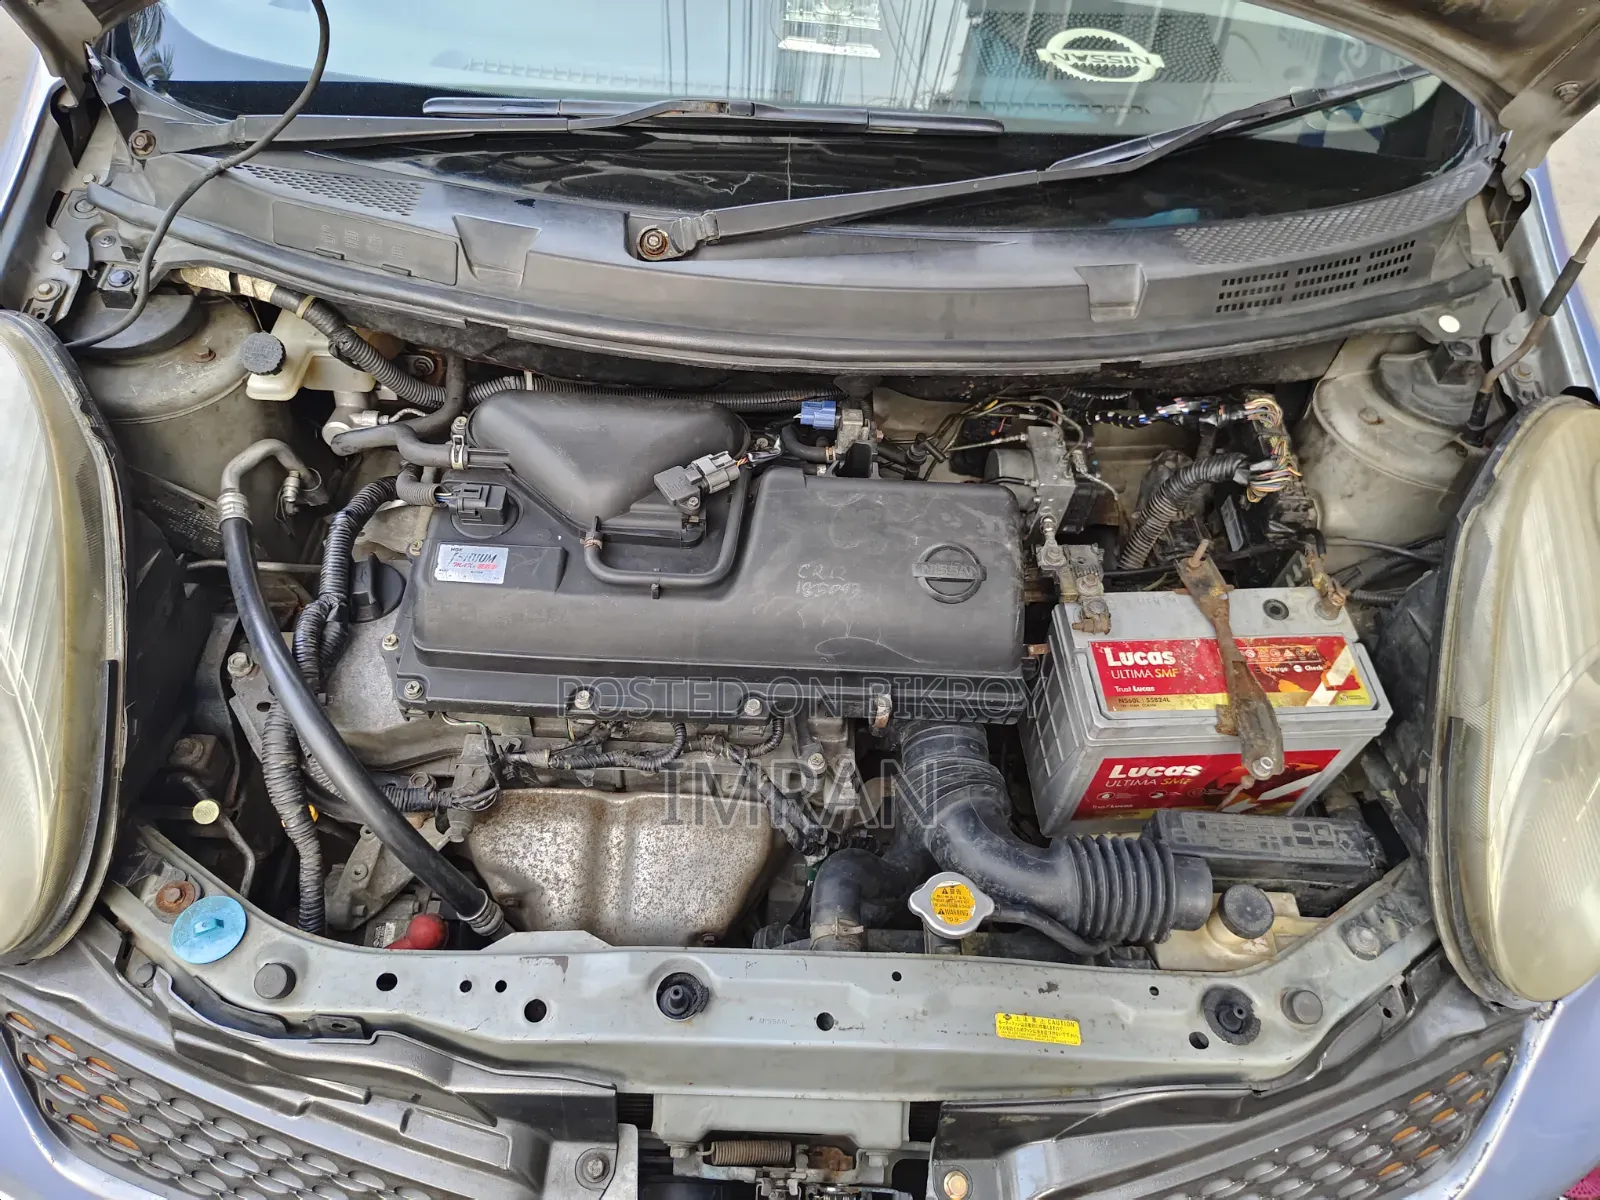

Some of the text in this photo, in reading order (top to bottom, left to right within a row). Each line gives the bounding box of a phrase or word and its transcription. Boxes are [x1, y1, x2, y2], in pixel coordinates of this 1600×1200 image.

[1050, 52, 1152, 65] NISSAN
[921, 564, 981, 578] NISSAN
[1104, 647, 1177, 667] Lucas
[1111, 668, 1180, 679] ULTIMA SMF
[1108, 764, 1203, 779] Lucas
[1105, 778, 1194, 788] ULTIMA SMF
